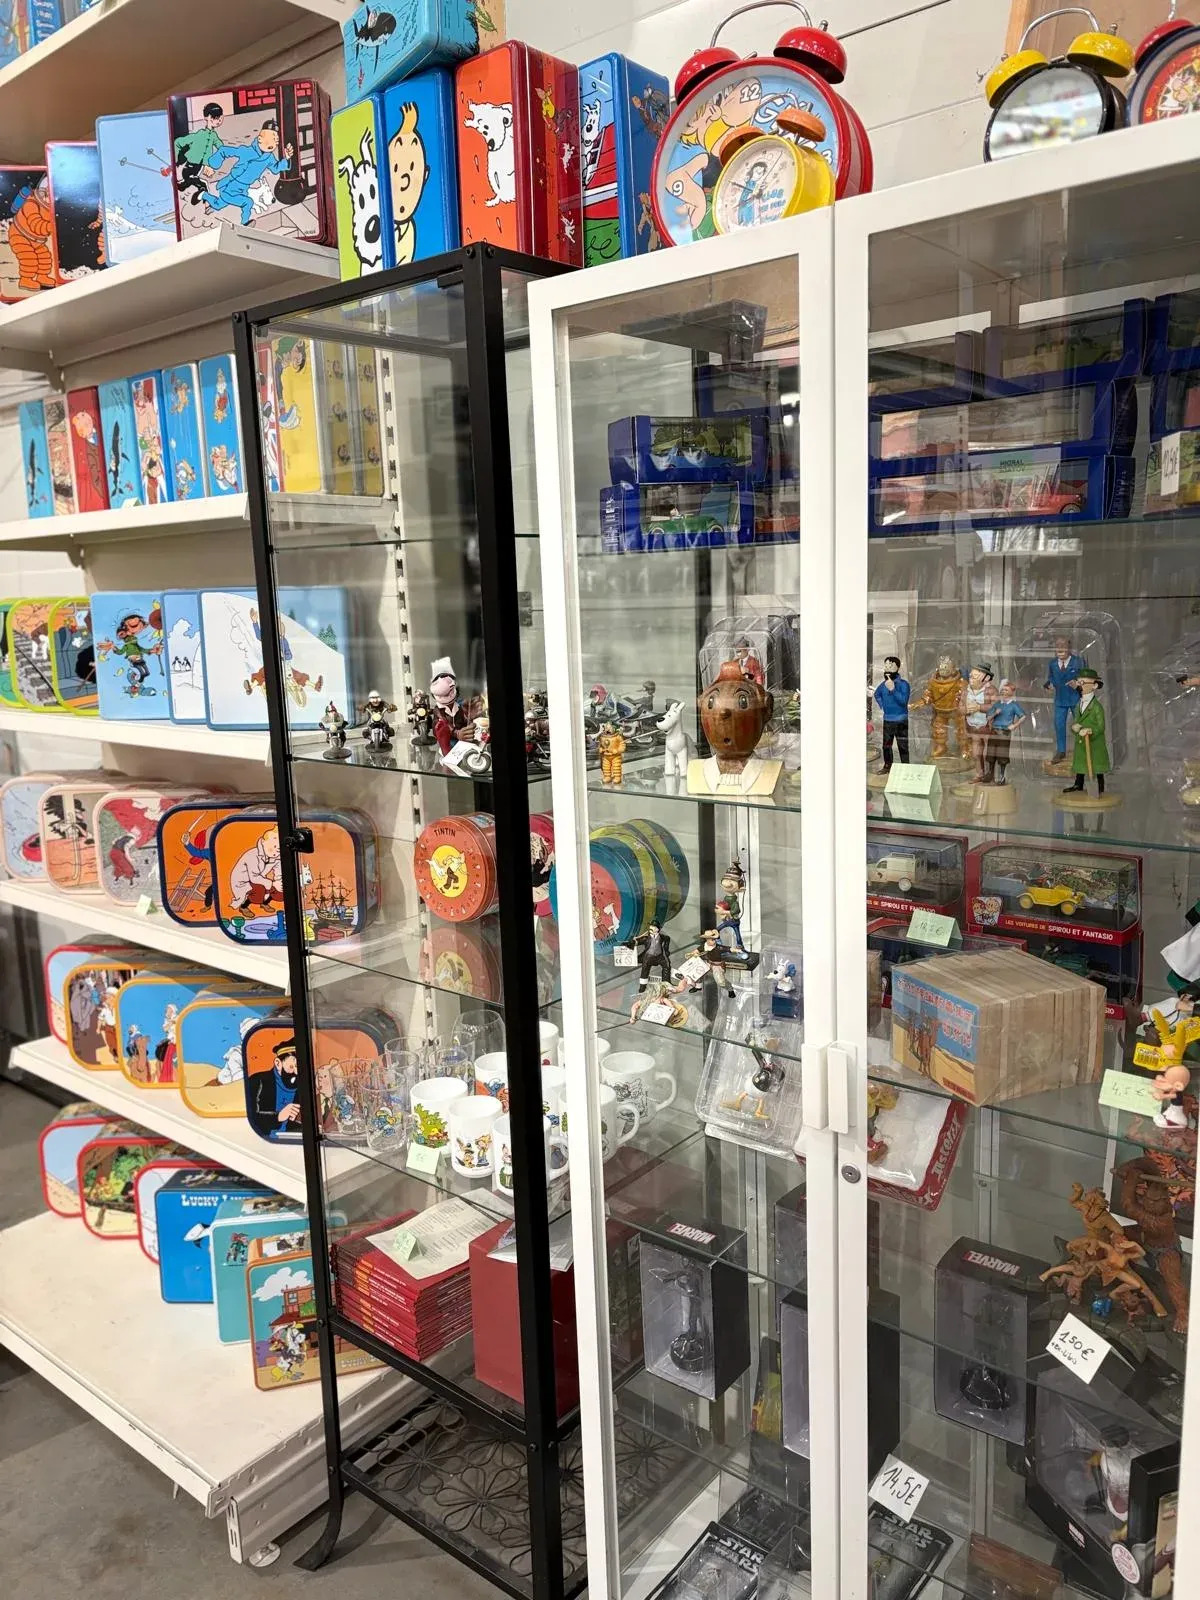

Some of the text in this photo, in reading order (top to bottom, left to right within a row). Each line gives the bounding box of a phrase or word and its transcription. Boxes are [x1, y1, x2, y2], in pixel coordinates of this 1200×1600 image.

[740, 83, 760, 103] 12
[1145, 106, 1153, 117] 9
[822, 150, 833, 165] 3
[672, 179, 684, 196] 9
[434, 827, 456, 837] TINTIN
[880, 900, 900, 910] SPIROU
[1015, 920, 1038, 929] VOITURES
[1048, 925, 1071, 935] SPIROU
[1082, 930, 1113, 941] FANTASIO
[180, 1193, 220, 1208] LUCKY
[668, 1222, 717, 1245] MARVEL
[967, 1250, 1021, 1276] MARVEL
[1058, 1331, 1096, 1362] 150€
[881, 1466, 923, 1507] 14,5€
[884, 1513, 935, 1541] STAR
[718, 1536, 765, 1564] STAR
